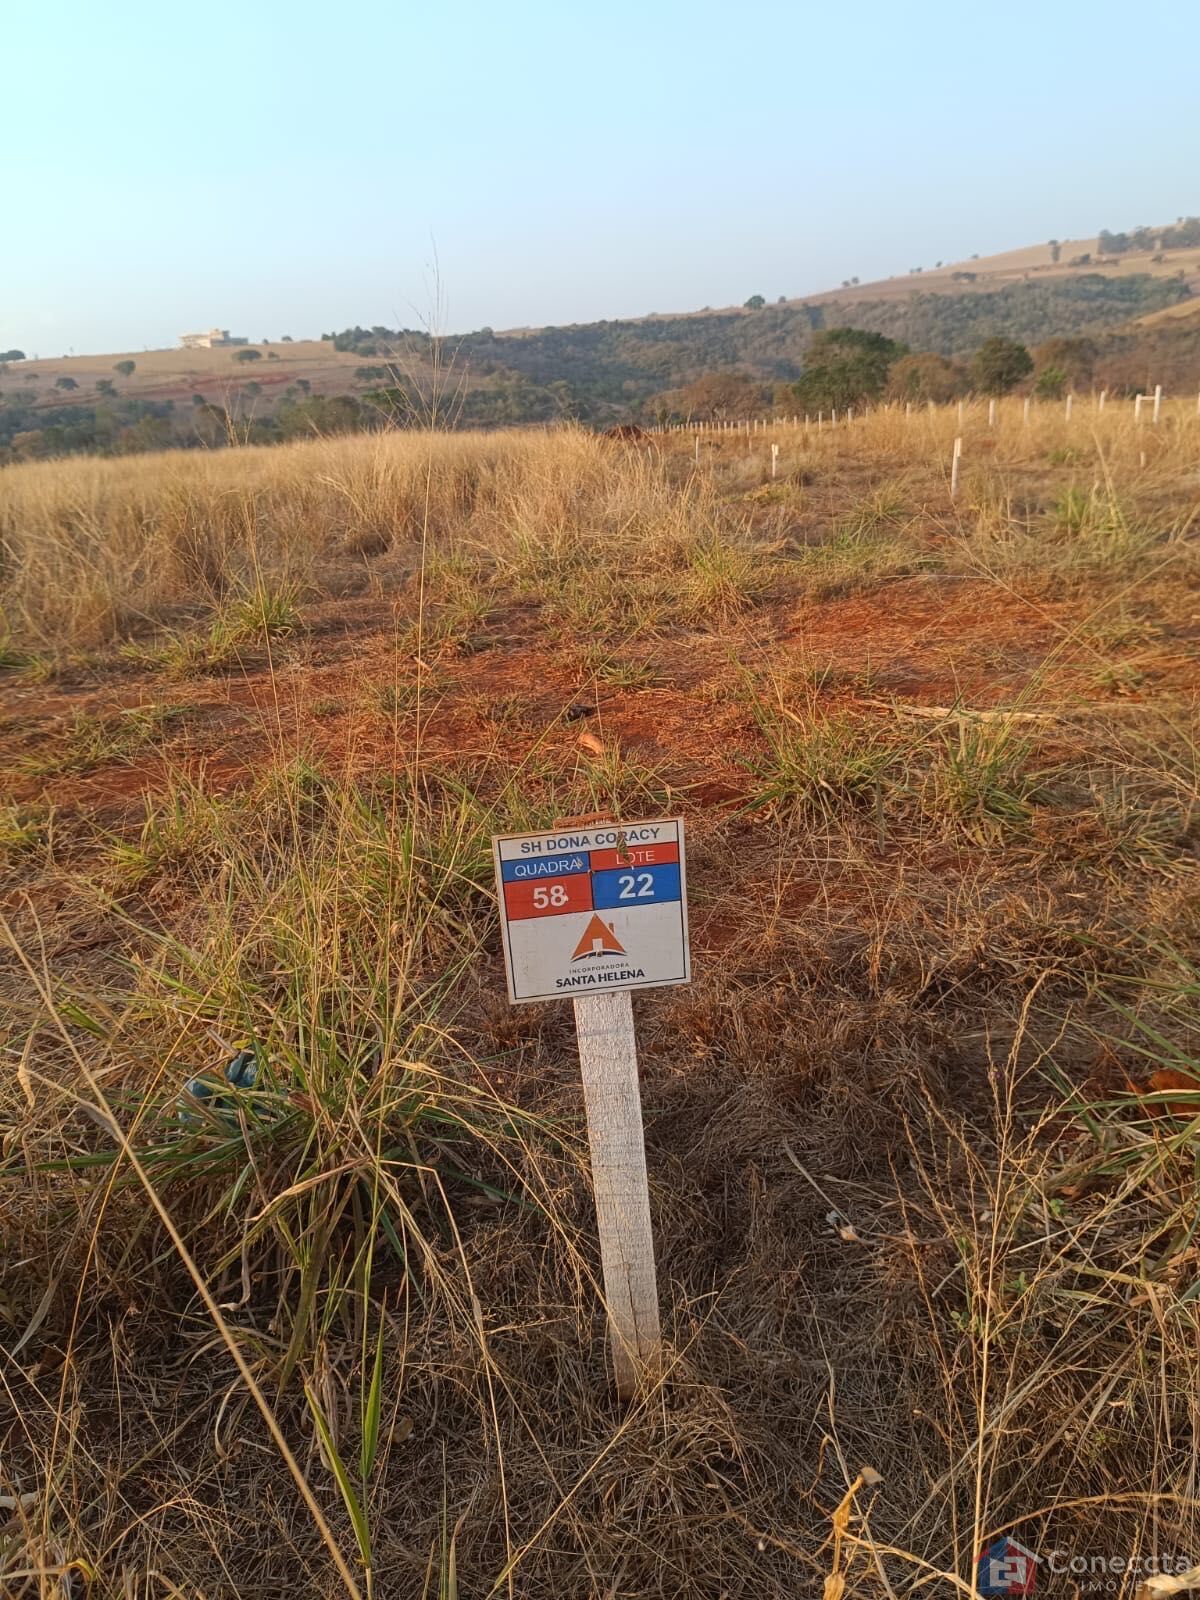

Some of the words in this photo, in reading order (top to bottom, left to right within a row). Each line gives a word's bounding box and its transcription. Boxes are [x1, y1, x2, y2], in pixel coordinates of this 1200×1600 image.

[520, 841, 542, 854] SH
[546, 835, 591, 851] DONA
[514, 859, 581, 877] QUADRA
[618, 873, 655, 899] 22
[532, 885, 568, 909] 58
[555, 974, 597, 988] SANTA
[598, 968, 645, 983] HELENA
[569, 963, 630, 974] INCORPORADORA
